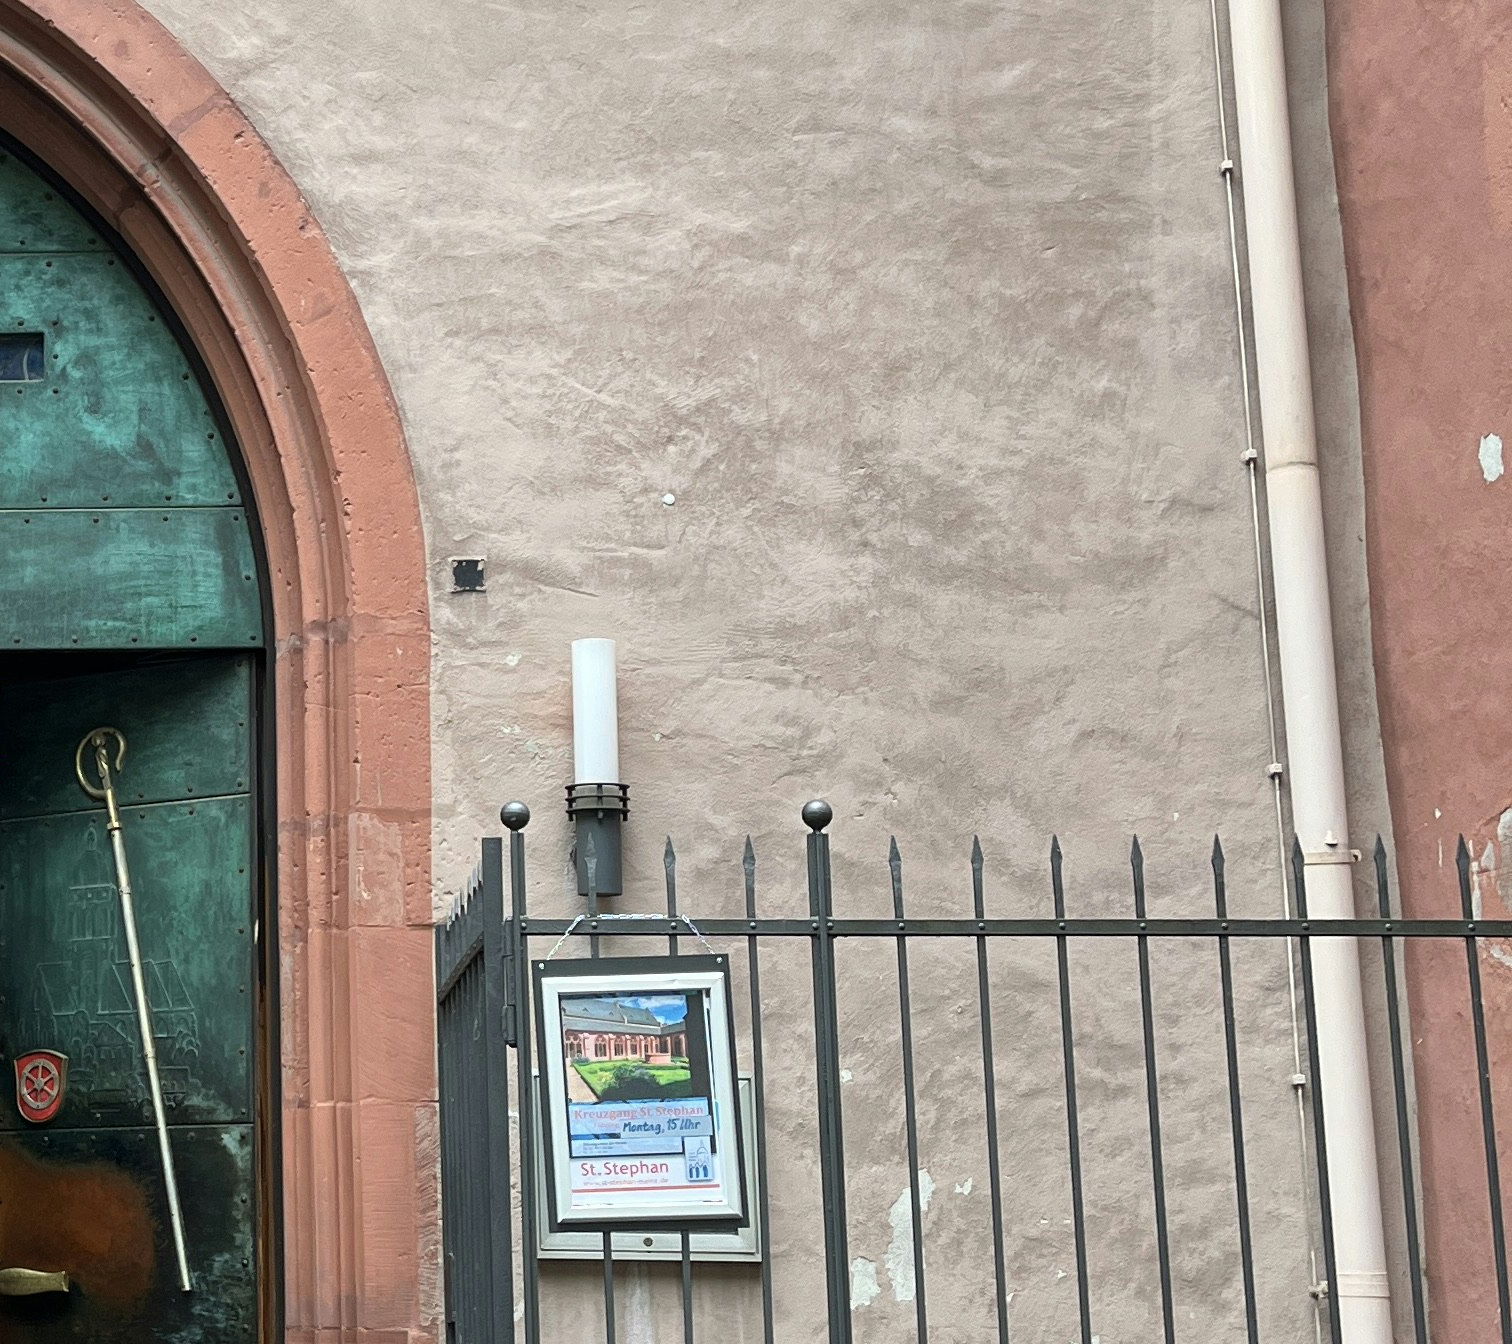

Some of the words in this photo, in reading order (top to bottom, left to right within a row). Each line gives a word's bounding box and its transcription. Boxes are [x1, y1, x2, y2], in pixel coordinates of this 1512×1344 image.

[574, 1108, 638, 1121] Kreuzgang
[655, 1105, 704, 1119] Stephan
[622, 1120, 665, 1135] Montag,
[666, 1118, 680, 1130] 15
[680, 1117, 702, 1131] Uhr
